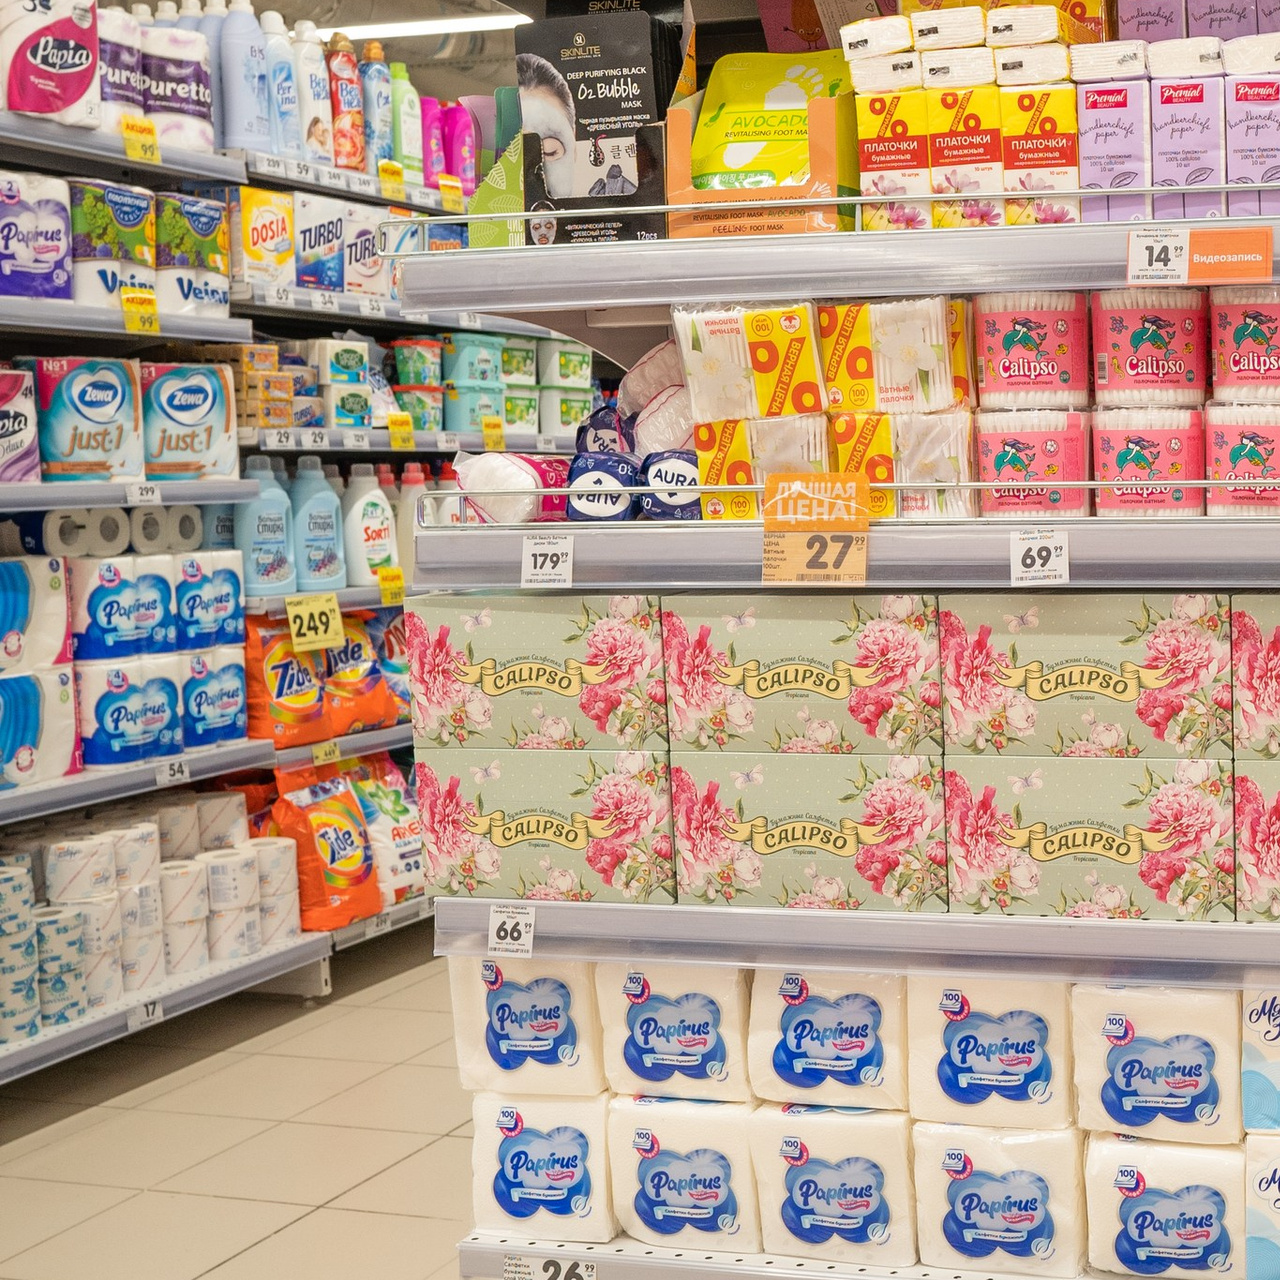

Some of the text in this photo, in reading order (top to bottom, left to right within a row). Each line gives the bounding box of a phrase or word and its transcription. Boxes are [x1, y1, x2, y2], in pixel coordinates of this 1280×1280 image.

[37, 36, 89, 70] Papia
[561, 45, 600, 57] SKINLITE
[567, 66, 646, 79] DEEP PURIFYING BLACK
[597, 78, 640, 99] Bubble
[621, 100, 642, 108] MASK
[1246, 122, 1270, 136] paper
[864, 141, 918, 152] ПЛАТОЧКИ
[1011, 138, 1067, 149] ПЛАТОЧКИ
[1019, 152, 1059, 161] бумажные
[251, 216, 288, 246] DOSIA
[300, 218, 342, 251] TURBO
[712, 223, 747, 233] PEELING
[749, 223, 765, 231] FOOT
[324, 243, 336, 256] LINE
[1146, 245, 1171, 267] 14
[1192, 251, 1262, 264] Видеозапись
[828, 306, 859, 380] ВЕРНАЯ ЦЕНА
[999, 356, 1058, 378] Calipso
[84, 387, 112, 402] Zewa
[139, 487, 155, 496] 299
[776, 499, 856, 523] ЦЕНА!
[805, 534, 865, 569] 27 99
[1021, 546, 1051, 569] 69
[531, 553, 561, 571] 179
[293, 614, 329, 638] 249
[762, 654, 830, 670] Бумажные Салфетки
[271, 659, 311, 700] Tide
[494, 668, 572, 690] CALIPSO
[757, 670, 840, 693] CALIPSO
[169, 763, 184, 776] 54
[496, 921, 522, 941] 66
[144, 1001, 156, 1018] 17
[496, 1004, 561, 1029] Papirus
[510, 1152, 578, 1179] Papirus
